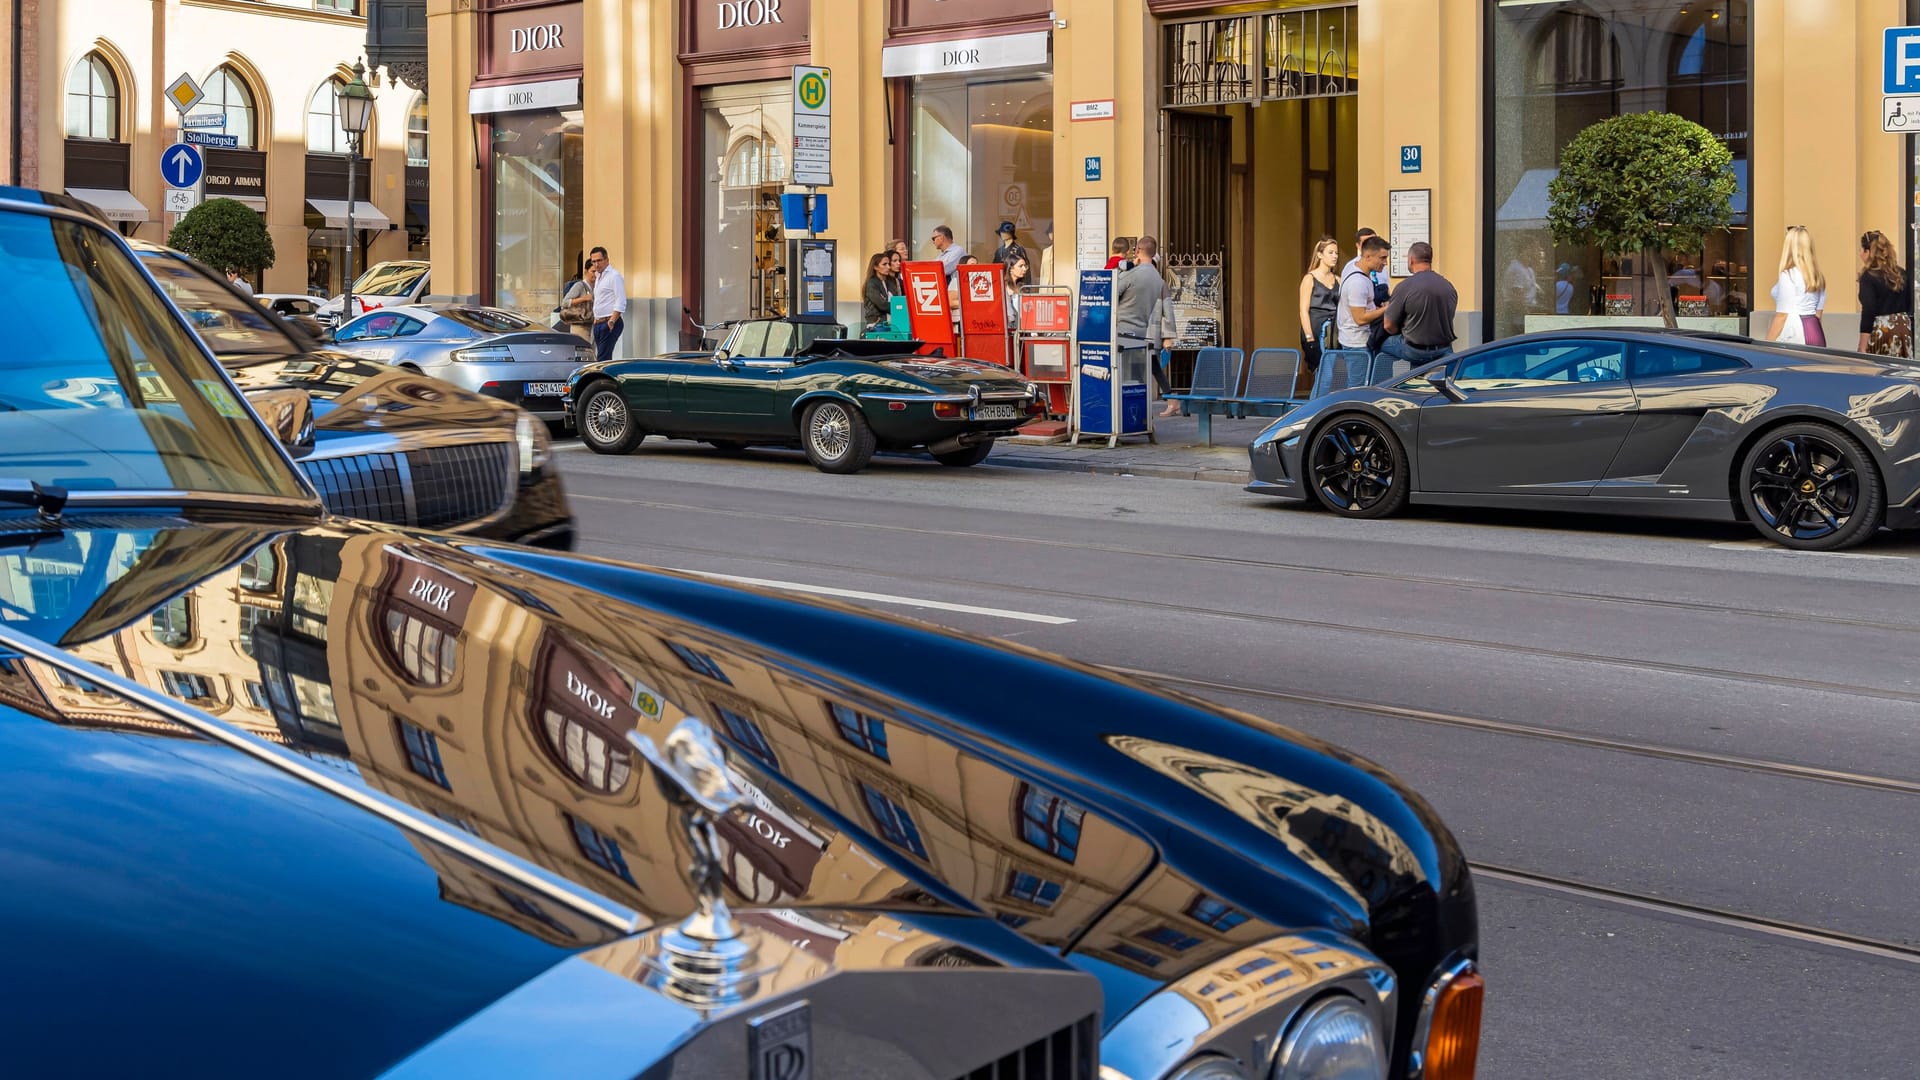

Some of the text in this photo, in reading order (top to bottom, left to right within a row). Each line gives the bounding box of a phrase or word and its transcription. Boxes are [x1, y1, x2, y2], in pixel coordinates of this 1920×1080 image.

[715, 0, 782, 30] DIOR
[510, 23, 564, 53] DIOR
[943, 49, 980, 66] DIOR
[806, 80, 819, 101] H
[508, 91, 534, 105] DIOR
[187, 132, 236, 147] Stollbergstr.
[1403, 147, 1418, 161] 30
[206, 176, 261, 186] ORGIO ARMANI
[1392, 223, 1398, 232] 3
[912, 276, 942, 312] tz
[540, 383, 549, 393] SM
[984, 406, 996, 418] RH
